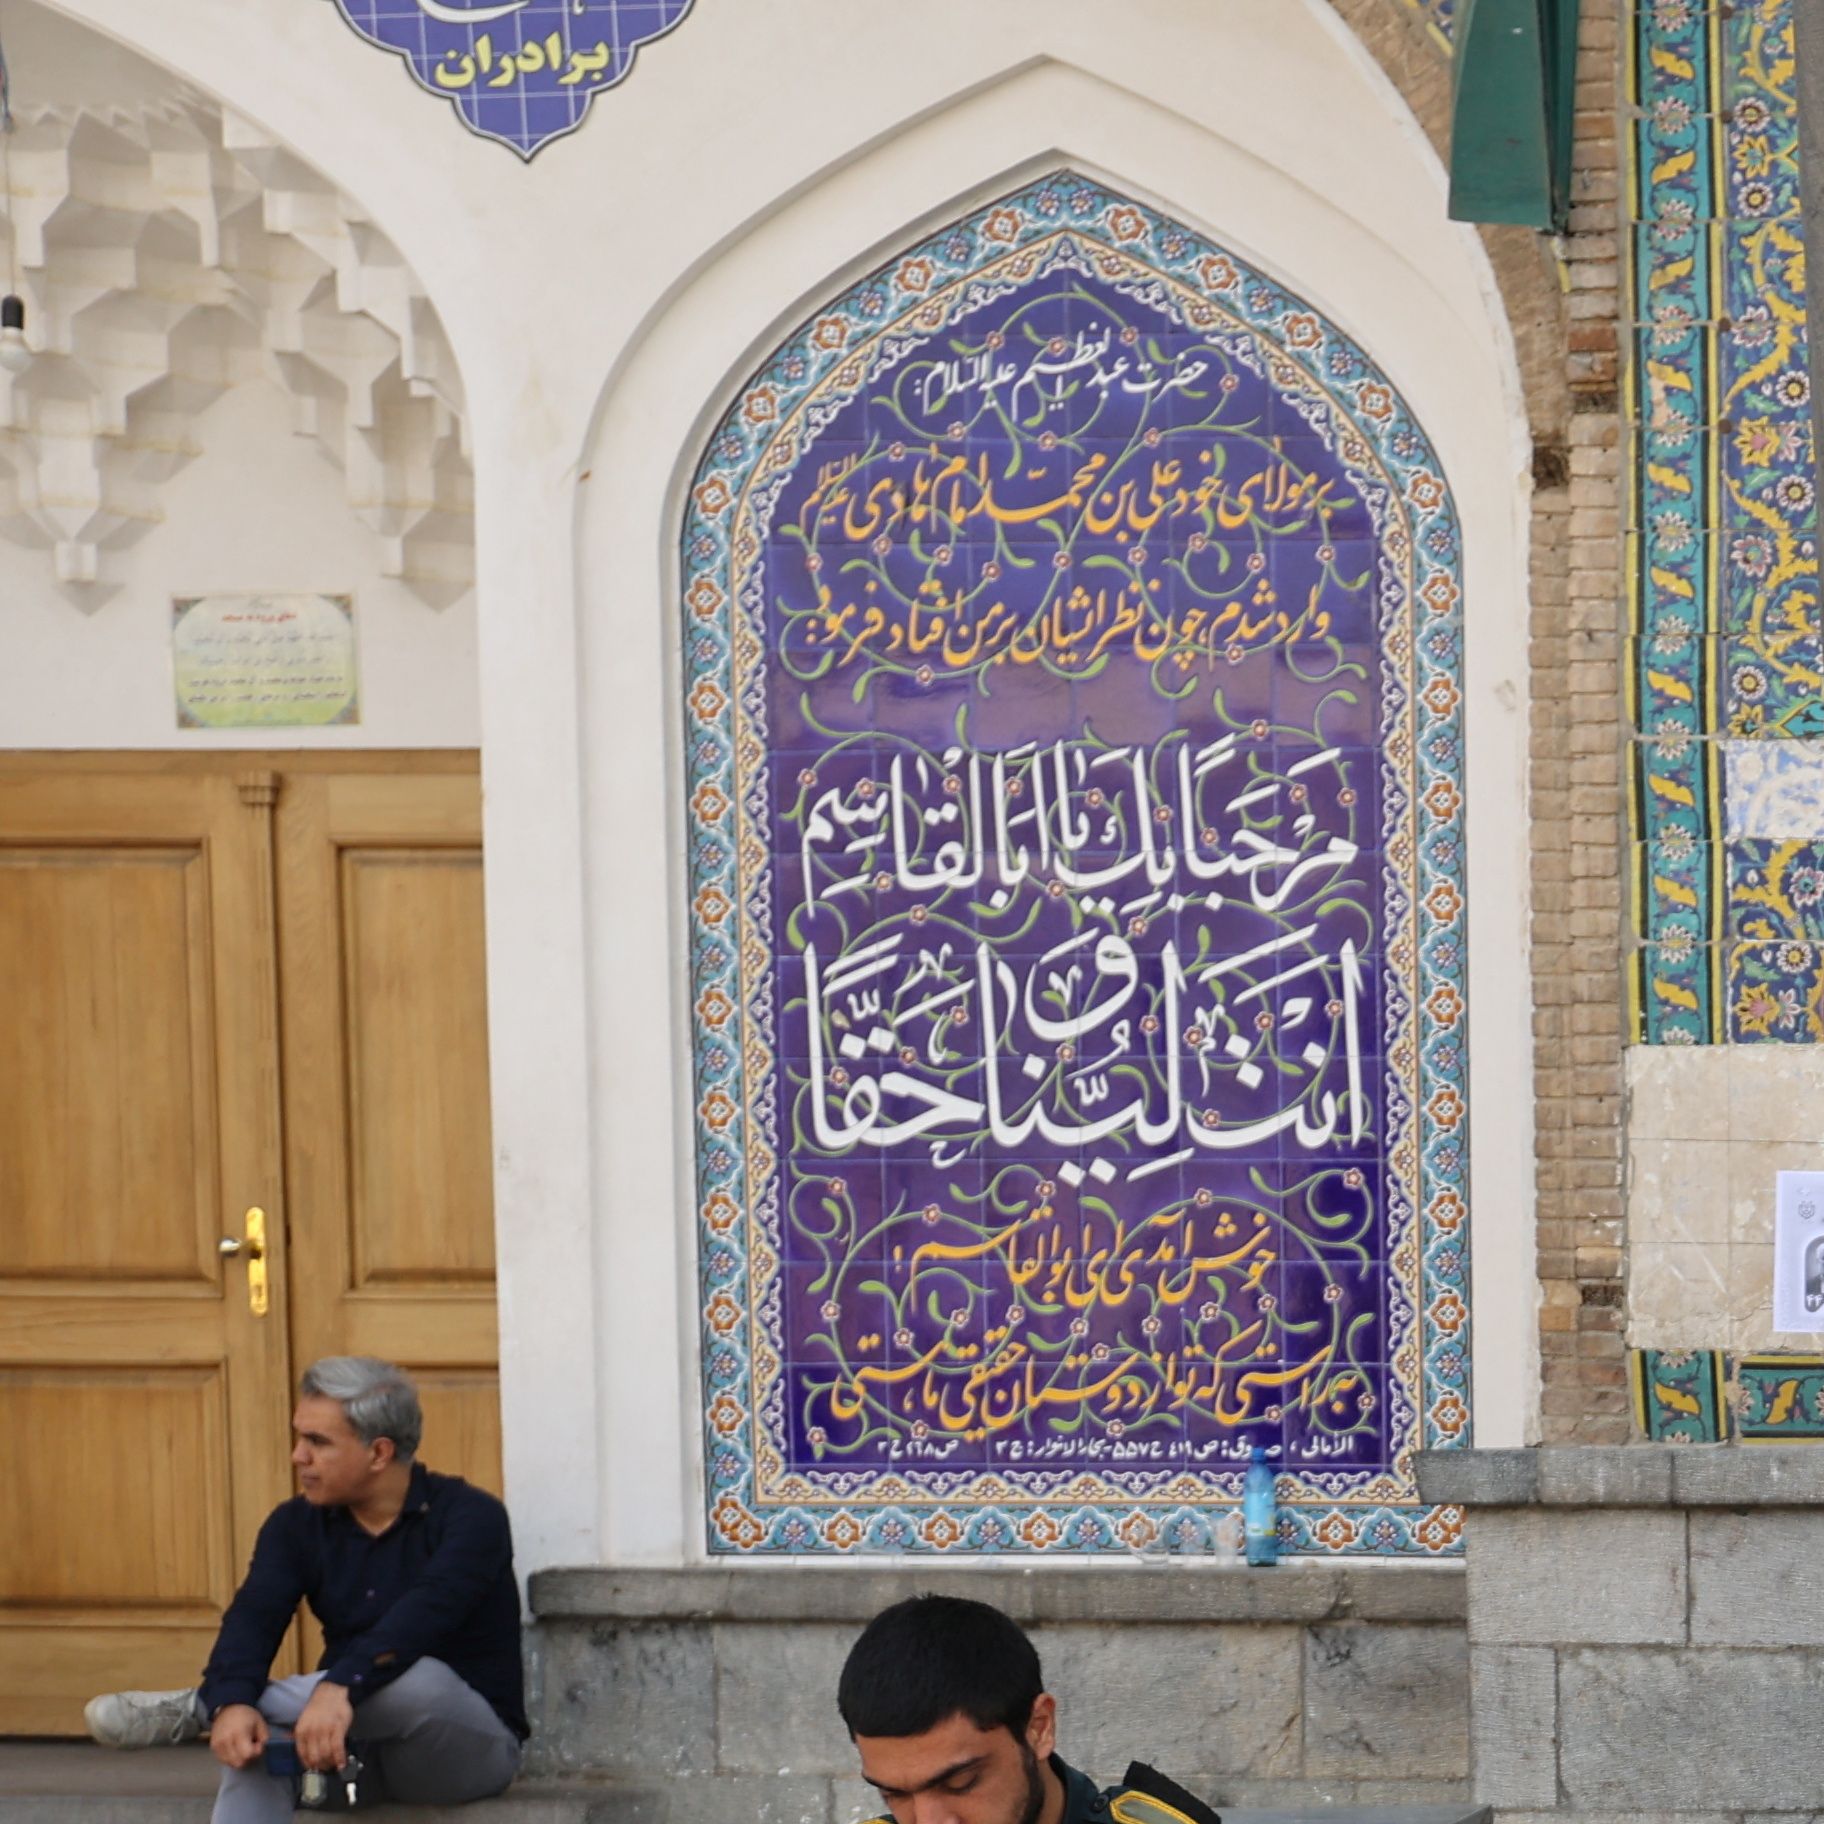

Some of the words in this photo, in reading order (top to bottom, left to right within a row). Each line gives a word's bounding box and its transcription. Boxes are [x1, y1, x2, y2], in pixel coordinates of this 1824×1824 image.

[434, 31, 610, 89] برادران
[1122, 352, 1209, 404] حضرت
[1084, 478, 1137, 543] بن
[1127, 459, 1184, 531] علی
[1168, 450, 1224, 520] خود
[886, 578, 965, 654] افتاد
[942, 601, 1005, 667] من
[984, 611, 1019, 666] بر
[1085, 578, 1162, 663] نظر
[1133, 606, 1209, 672] چون
[1270, 583, 1332, 646] وارد
[1100, 1207, 1195, 1306] آمدی
[1156, 1210, 1279, 1307] خوش
[938, 1325, 1029, 1442] حقیقی
[1192, 1319, 1264, 1400] که
